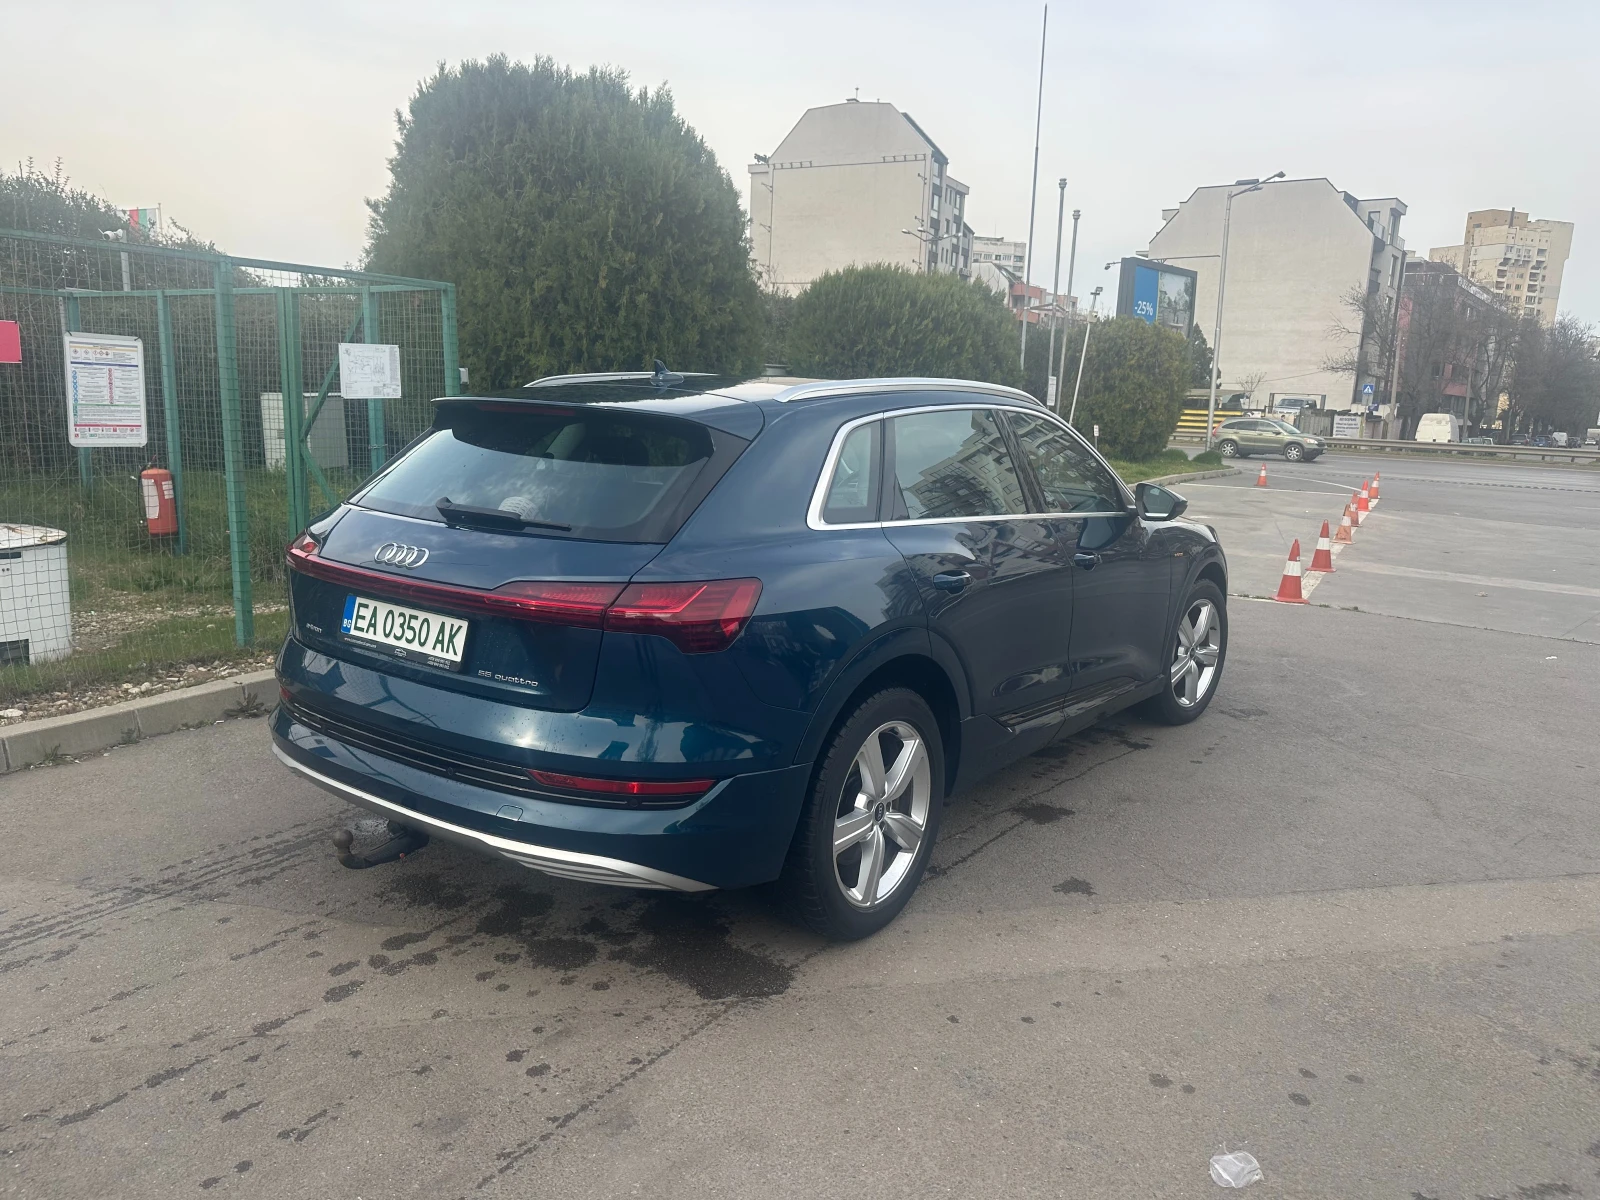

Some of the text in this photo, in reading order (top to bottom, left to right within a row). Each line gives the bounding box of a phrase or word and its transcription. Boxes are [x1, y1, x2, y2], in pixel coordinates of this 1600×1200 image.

[1134, 300, 1154, 316] -25%
[343, 618, 352, 628] BG
[354, 602, 463, 656] EA 0350 AK
[477, 669, 539, 687] 55 quattro
